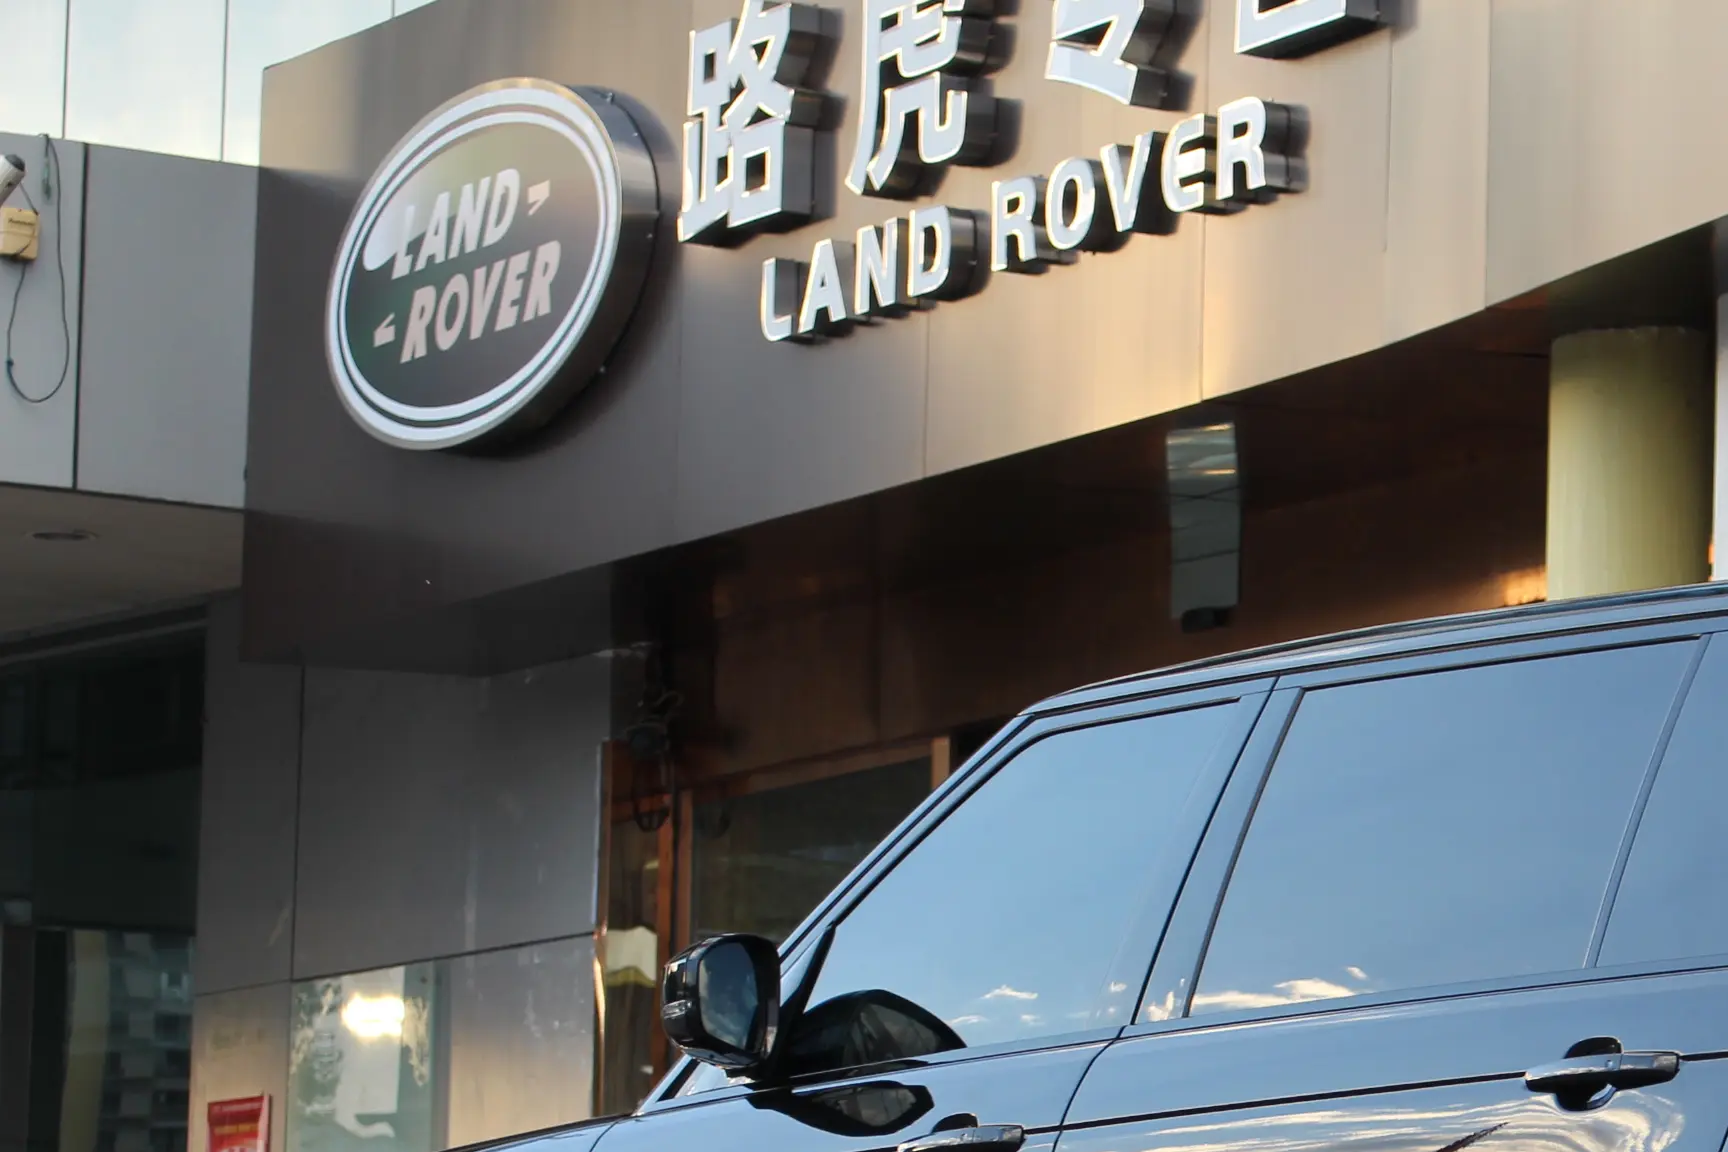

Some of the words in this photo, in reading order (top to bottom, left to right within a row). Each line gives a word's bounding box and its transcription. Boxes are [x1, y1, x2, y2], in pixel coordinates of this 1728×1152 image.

[677, 0, 1346, 242] 路虎
[392, 169, 520, 280] LAND
[400, 240, 561, 364] ROVER
[761, 205, 951, 342] LAND
[991, 96, 1267, 272] ROVER
